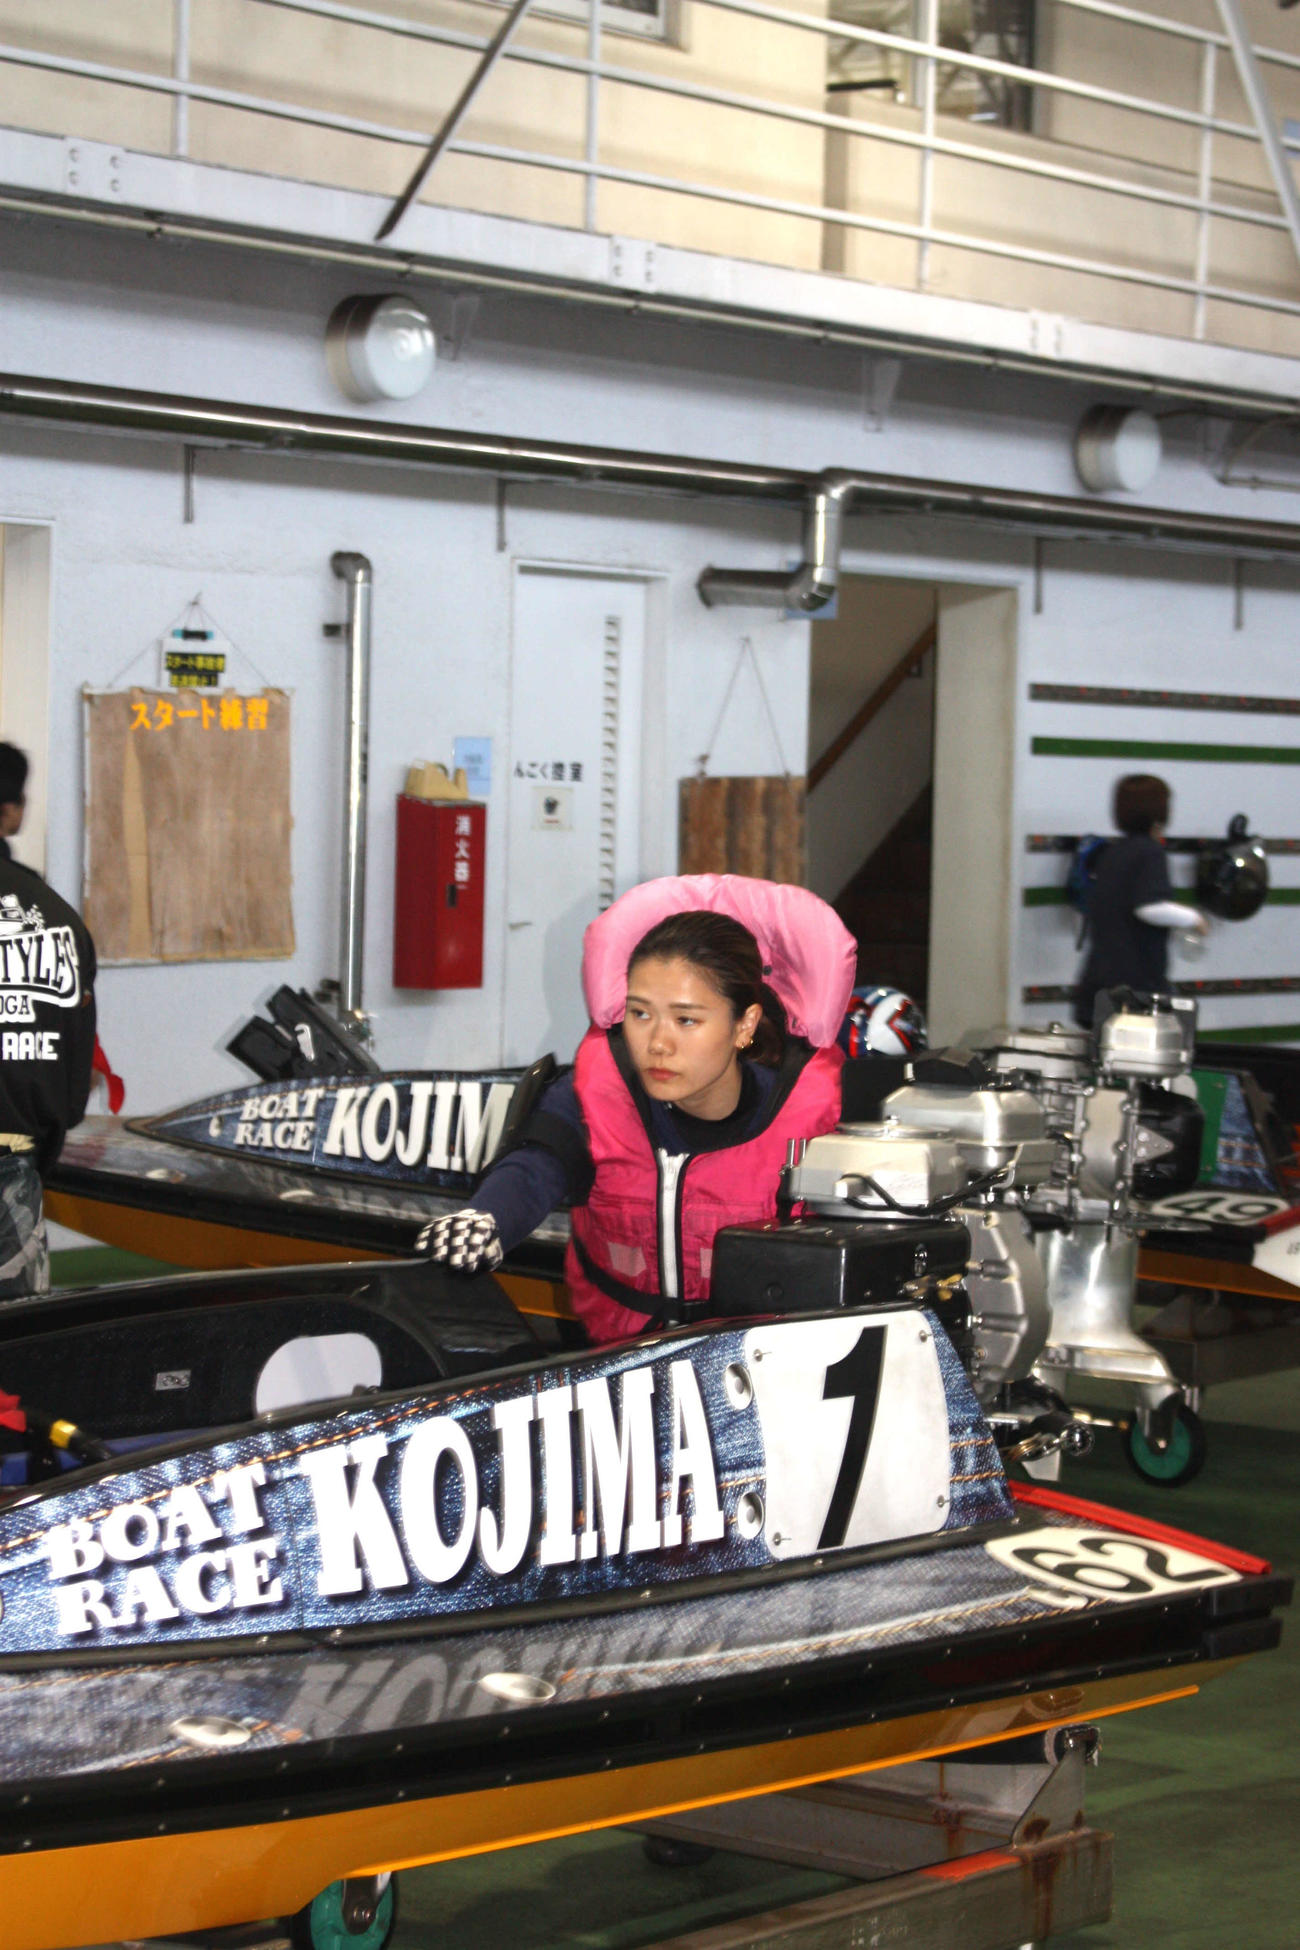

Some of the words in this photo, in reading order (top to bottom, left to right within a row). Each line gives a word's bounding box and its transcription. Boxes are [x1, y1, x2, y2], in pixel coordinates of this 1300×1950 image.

[129, 698, 269, 731] スタート練習
[455, 815, 472, 882] 消火器
[233, 1120, 317, 1151] RACE
[239, 1088, 323, 1121] BOAT
[817, 1325, 889, 1550] 1
[301, 1359, 725, 1596] KOJIMA
[50, 1463, 269, 1579] BOAT
[56, 1535, 284, 1636] RACE
[1011, 1537, 1234, 1594] 62
